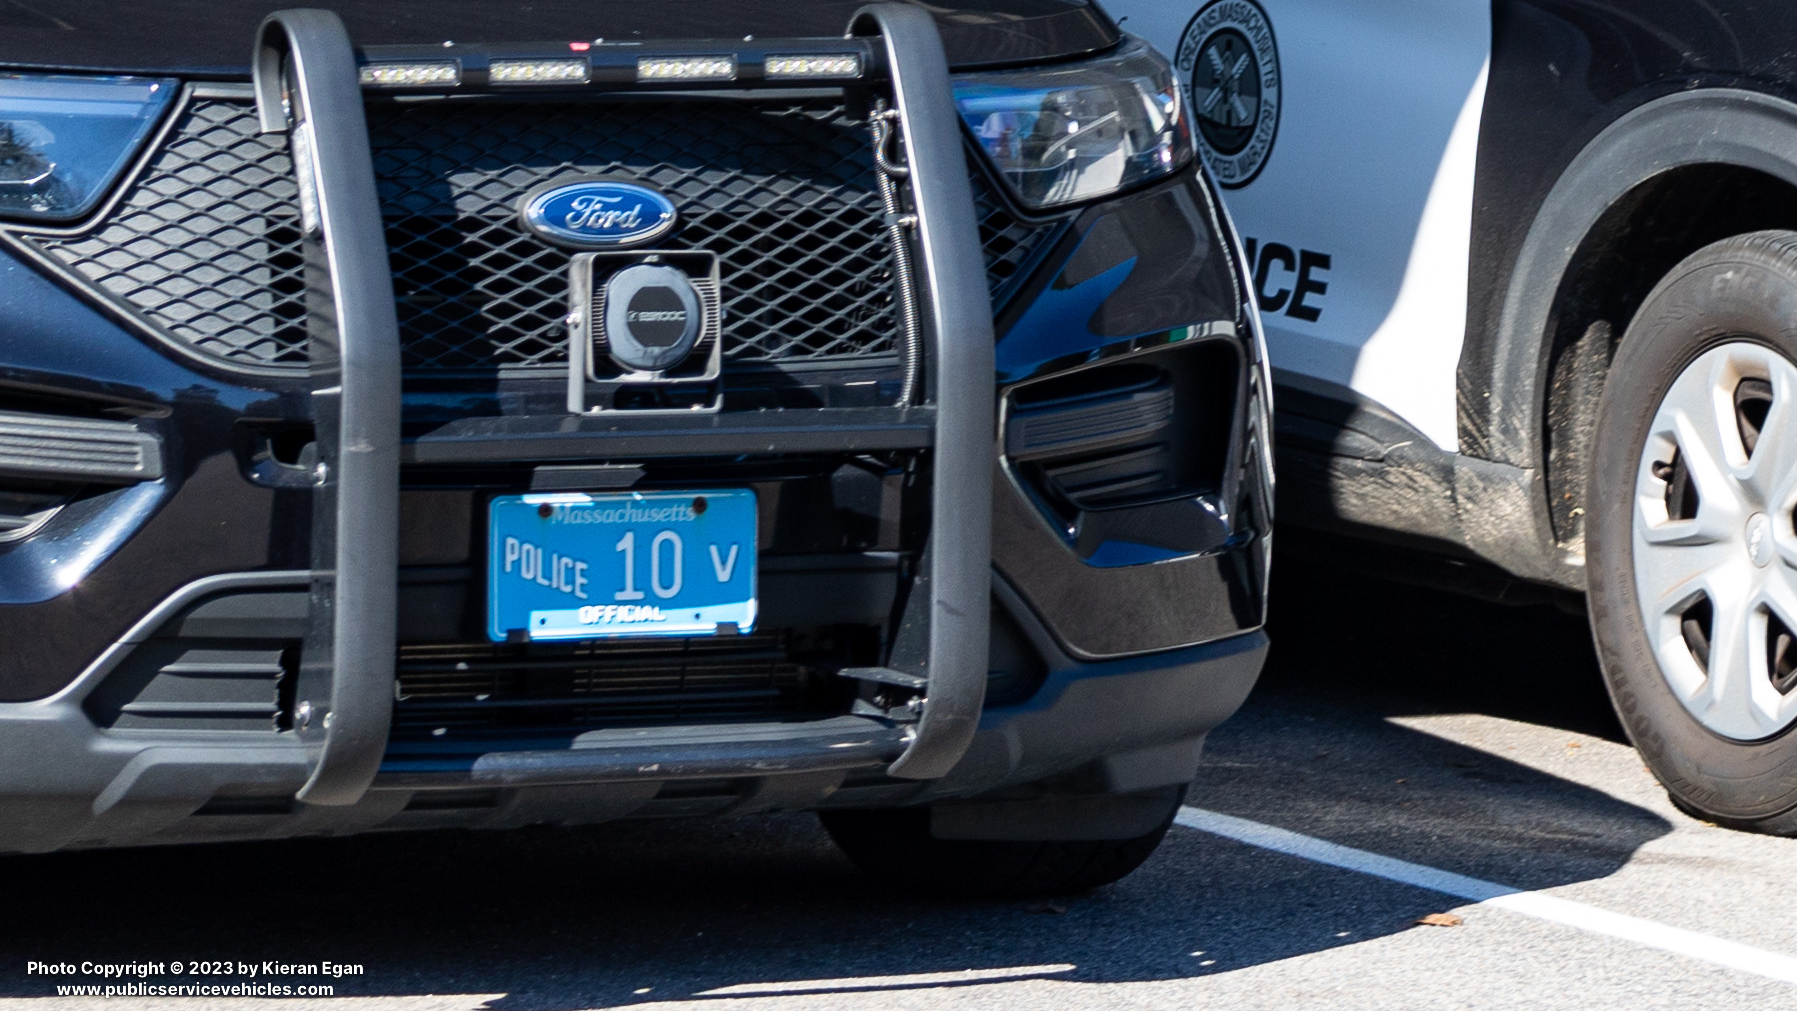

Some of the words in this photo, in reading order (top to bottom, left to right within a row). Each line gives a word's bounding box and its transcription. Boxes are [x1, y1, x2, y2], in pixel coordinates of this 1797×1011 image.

[565, 195, 643, 229] Ford
[552, 501, 697, 525] Massachusetts
[504, 537, 588, 600] POLICE
[614, 530, 683, 601] 10
[709, 544, 738, 582] V
[579, 604, 667, 625] OFFICIAL
